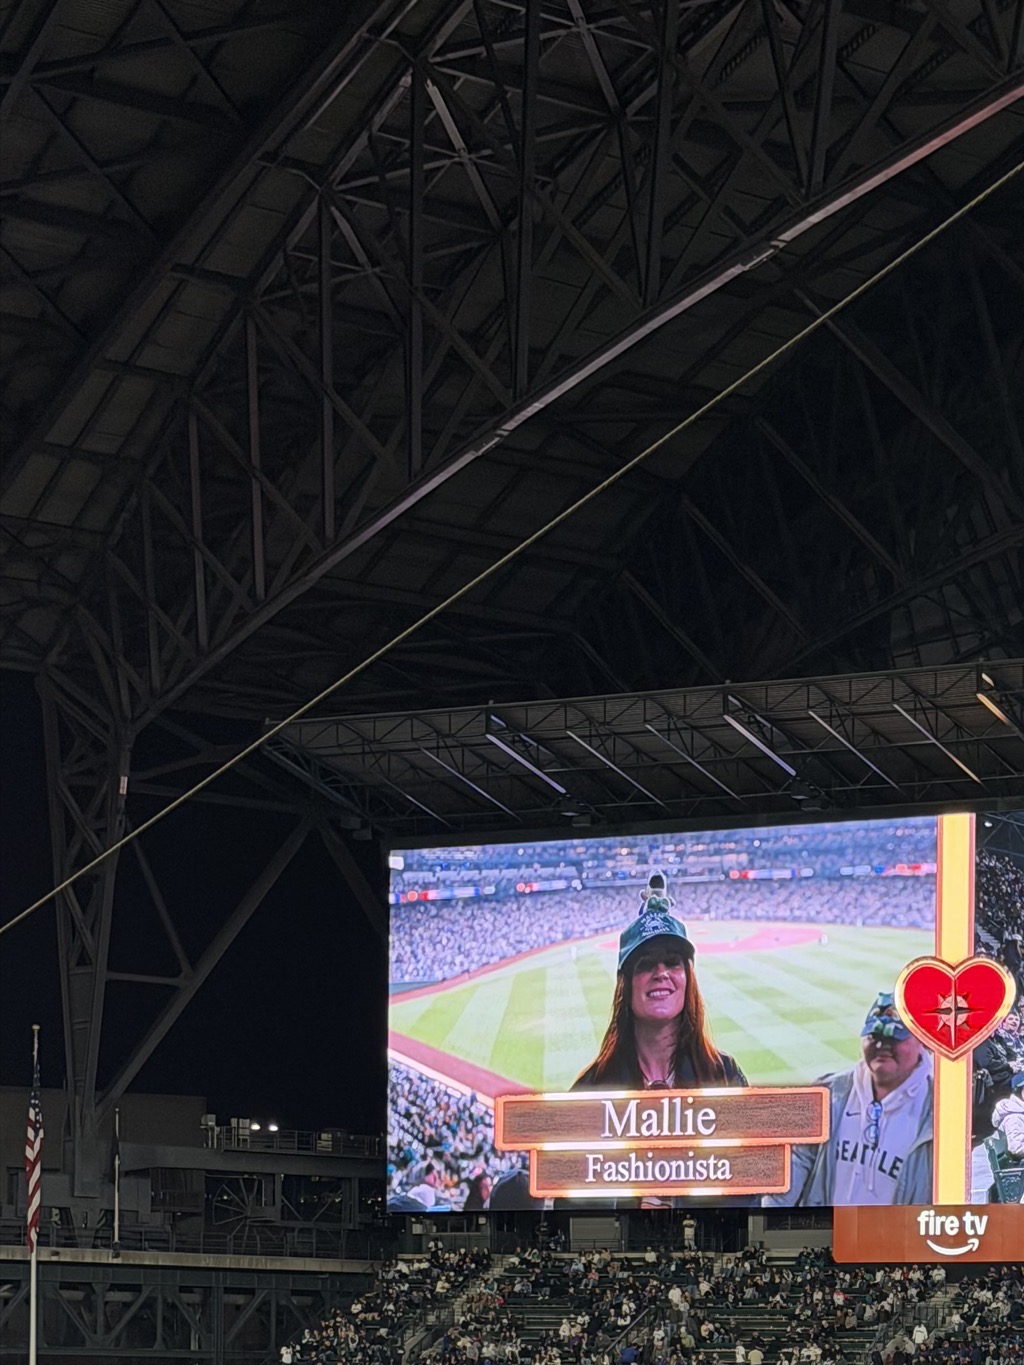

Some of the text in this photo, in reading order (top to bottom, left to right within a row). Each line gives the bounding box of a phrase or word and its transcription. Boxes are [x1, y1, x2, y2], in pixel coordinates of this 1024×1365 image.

[600, 1096, 717, 1138] Mallie
[585, 1151, 733, 1183] Fashionista
[917, 1209, 988, 1236] fire tv
